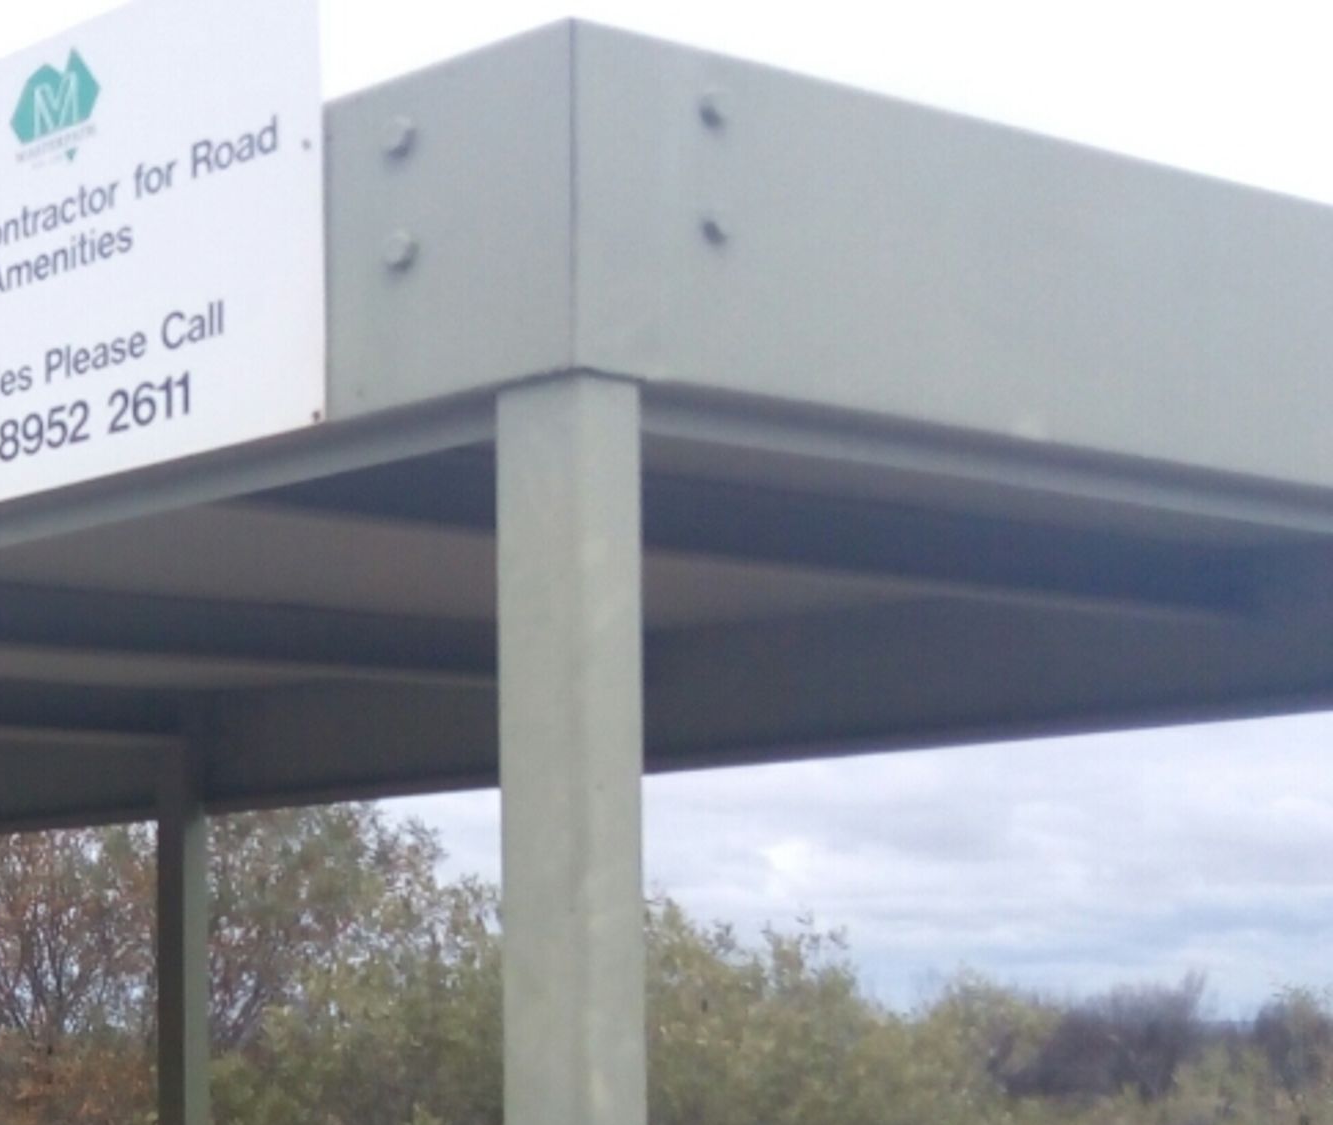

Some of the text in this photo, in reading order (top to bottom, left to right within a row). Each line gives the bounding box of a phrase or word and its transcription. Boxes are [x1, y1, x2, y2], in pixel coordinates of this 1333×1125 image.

[133, 160, 178, 199] for
[190, 114, 279, 180] Road
[44, 330, 149, 385] Please
[159, 299, 225, 351] Call
[106, 370, 192, 435] 2611
